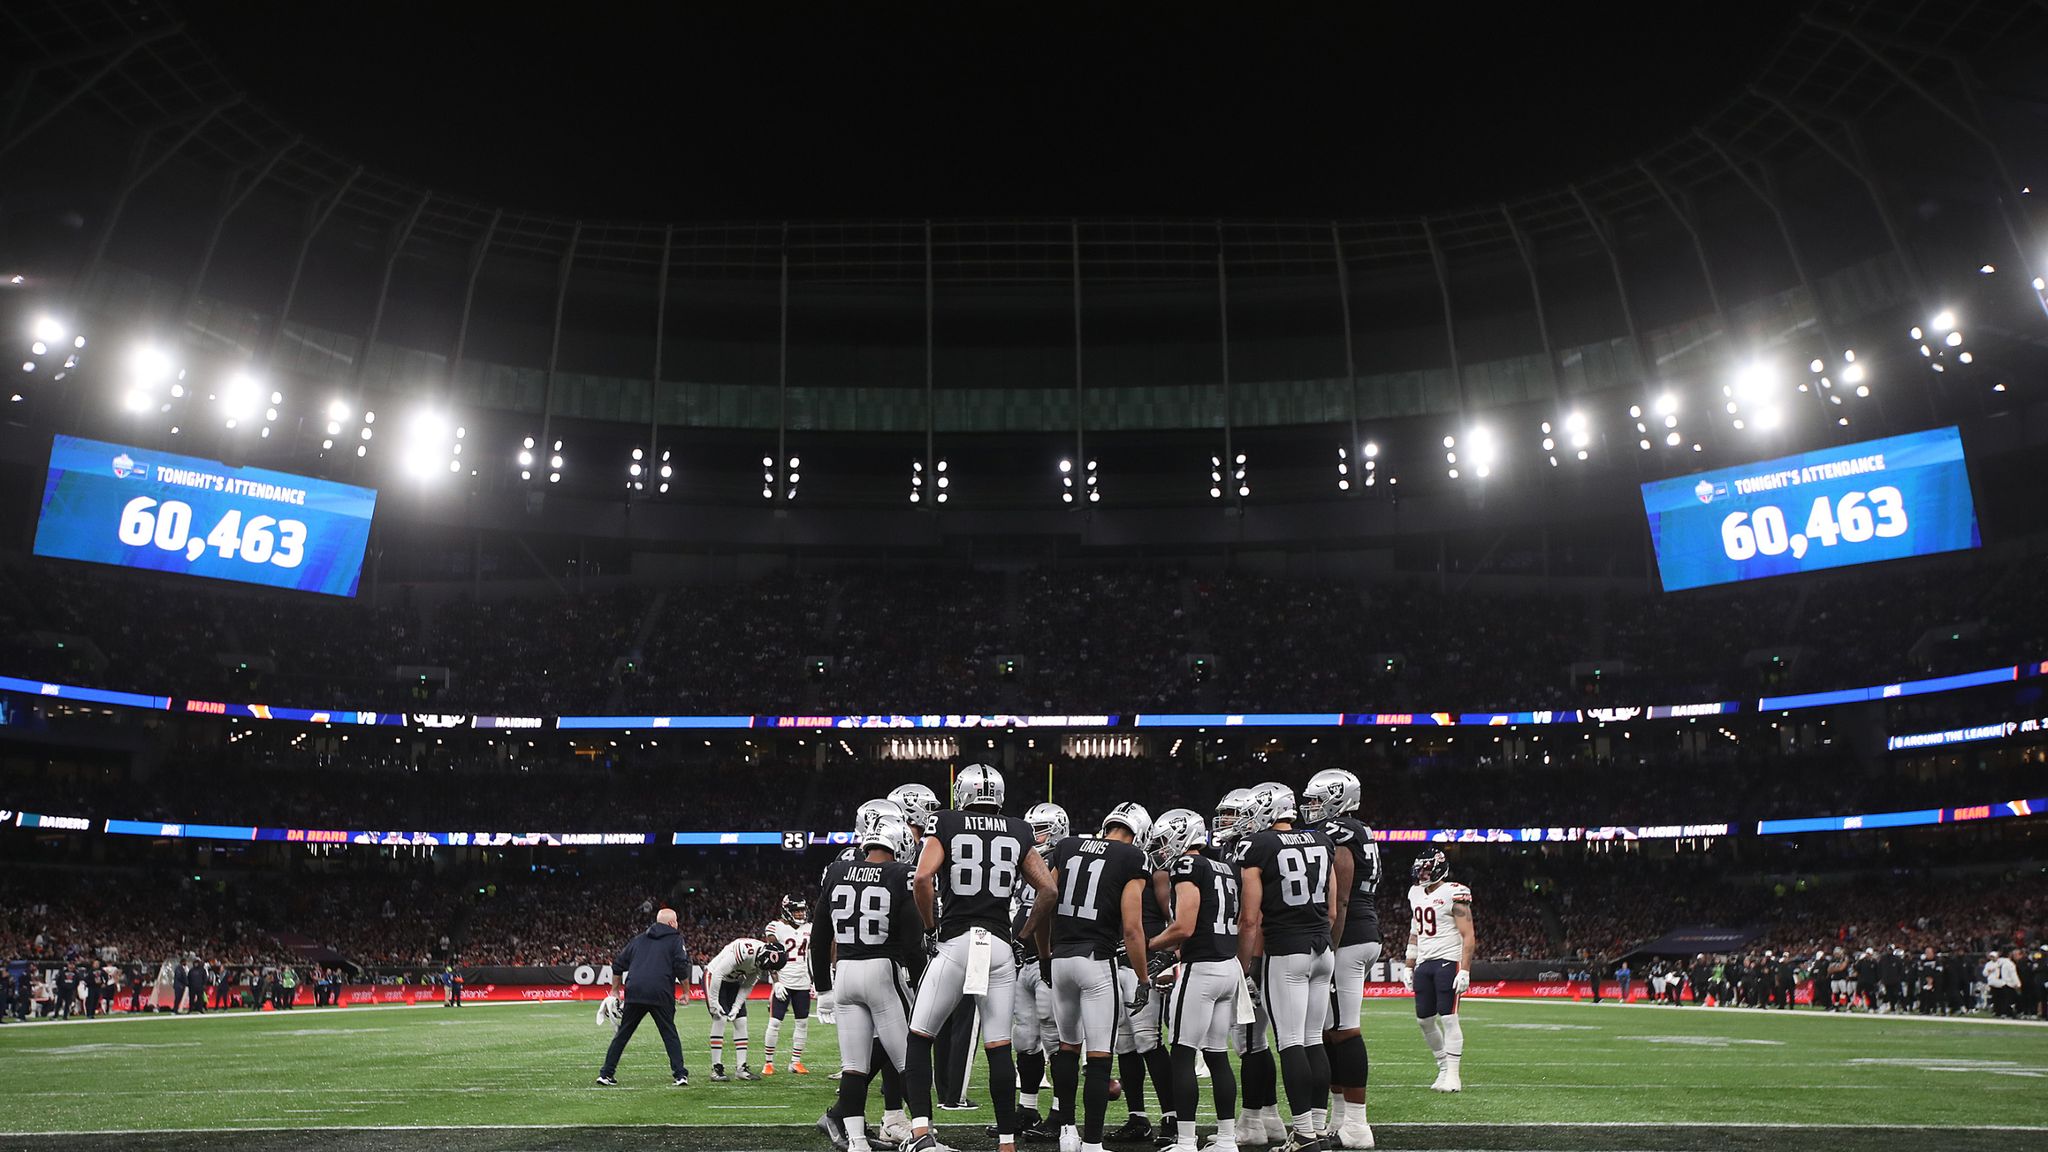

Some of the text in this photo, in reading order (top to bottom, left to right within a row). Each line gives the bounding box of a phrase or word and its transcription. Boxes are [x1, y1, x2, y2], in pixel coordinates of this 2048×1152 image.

[1735, 454, 1885, 495] TONIGHT'S ATTENDANCE
[157, 466, 306, 506] TONIGHT'S ATTENDANCE
[1721, 485, 1908, 561] 60,463
[118, 496, 307, 568] 60,463
[187, 700, 226, 714] BEARS
[1671, 702, 1721, 717] RAIDERS
[357, 711, 377, 725] VS
[495, 717, 542, 728] RAIDERS
[797, 716, 832, 727] BEARS
[1376, 714, 1413, 725] BEARS
[1533, 710, 1553, 724] VS
[1904, 732, 1944, 748] AROUND
[1944, 729, 1964, 743] THE
[1965, 724, 2002, 740] LEAGUE
[2021, 719, 2040, 733] ATL
[1954, 806, 1990, 820] BEARS
[39, 815, 90, 830] RAIDERS
[964, 816, 1008, 832] ATEMAN
[1683, 824, 1728, 836] NATION
[287, 829, 347, 842] DA BEARS
[448, 832, 468, 845] VS
[561, 833, 645, 845] RAIDER NATION
[784, 832, 804, 849] 25
[1277, 832, 1316, 846] MOREAU
[1389, 830, 1427, 841] BEARS
[1078, 839, 1107, 855] DAVIS
[950, 833, 1021, 898] 88
[843, 866, 883, 883] JACOBS
[1277, 845, 1329, 907] 87
[1057, 855, 1106, 921] 11
[1212, 874, 1240, 936] 13
[831, 884, 892, 945] 28
[1414, 906, 1437, 937] 99
[785, 937, 808, 962] 24
[521, 988, 573, 1000] virgin atlantic
